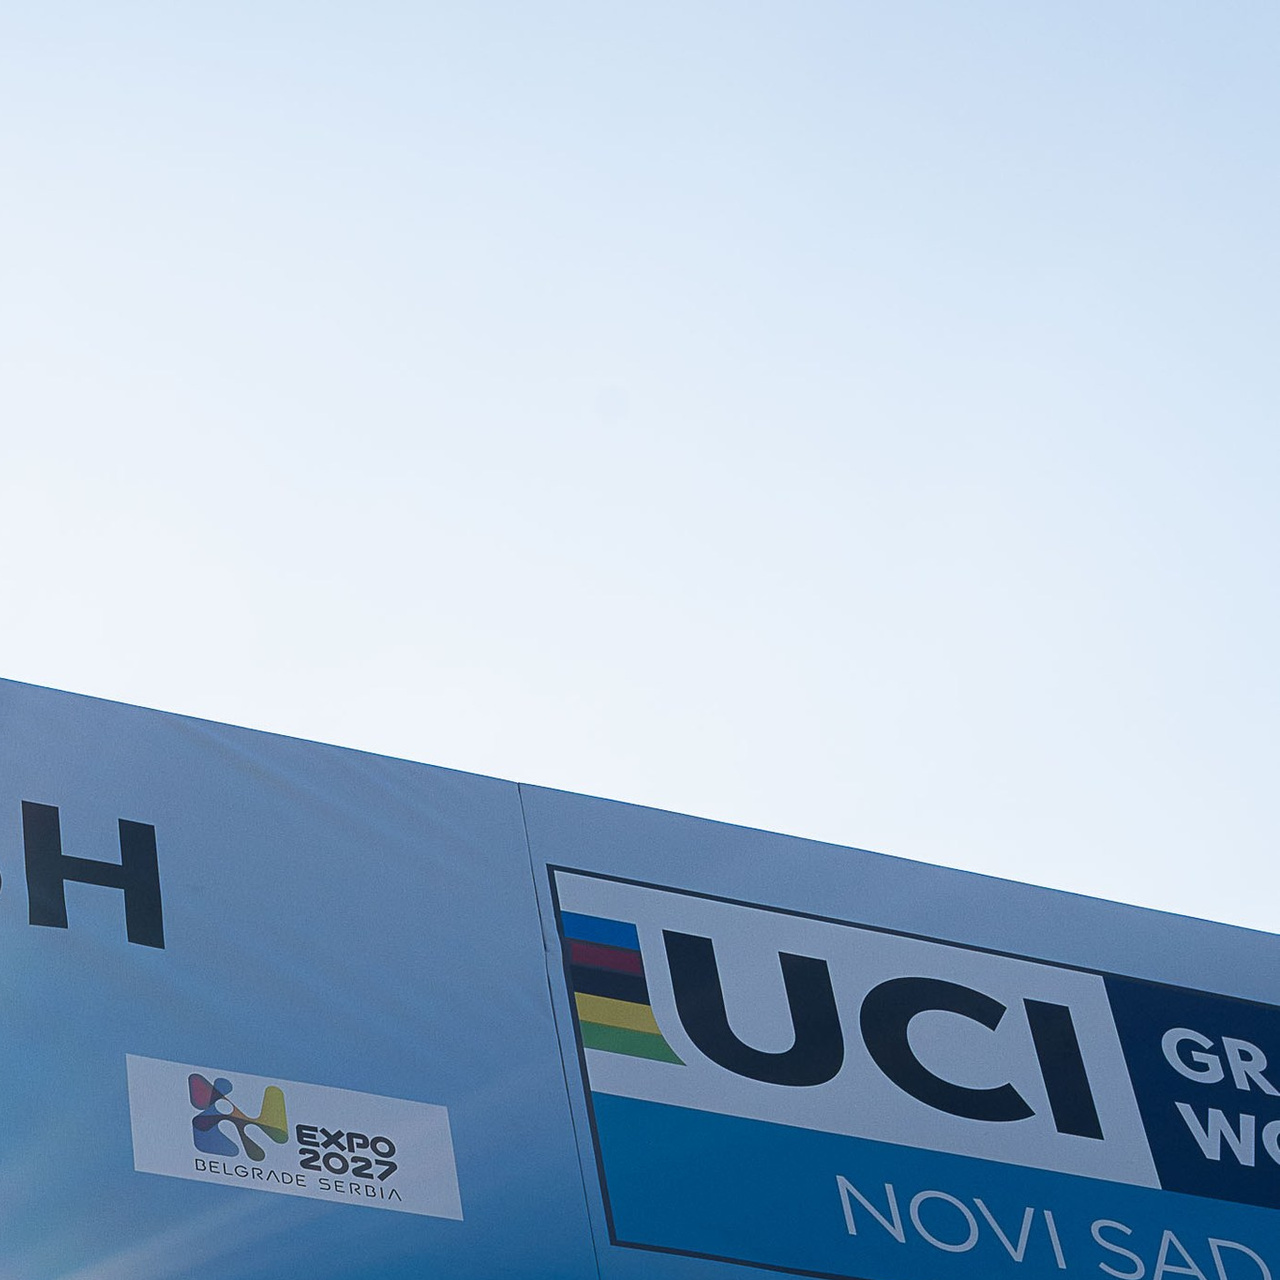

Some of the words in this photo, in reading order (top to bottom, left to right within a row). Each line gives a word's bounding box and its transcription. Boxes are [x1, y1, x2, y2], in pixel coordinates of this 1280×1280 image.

[662, 929, 1105, 1141] UCI
[295, 1124, 396, 1158] EXPO
[195, 1158, 307, 1187] BELGRADE
[319, 1178, 402, 1201] SERBIA
[299, 1148, 398, 1182] 2027
[836, 1175, 1067, 1269] NOVI
